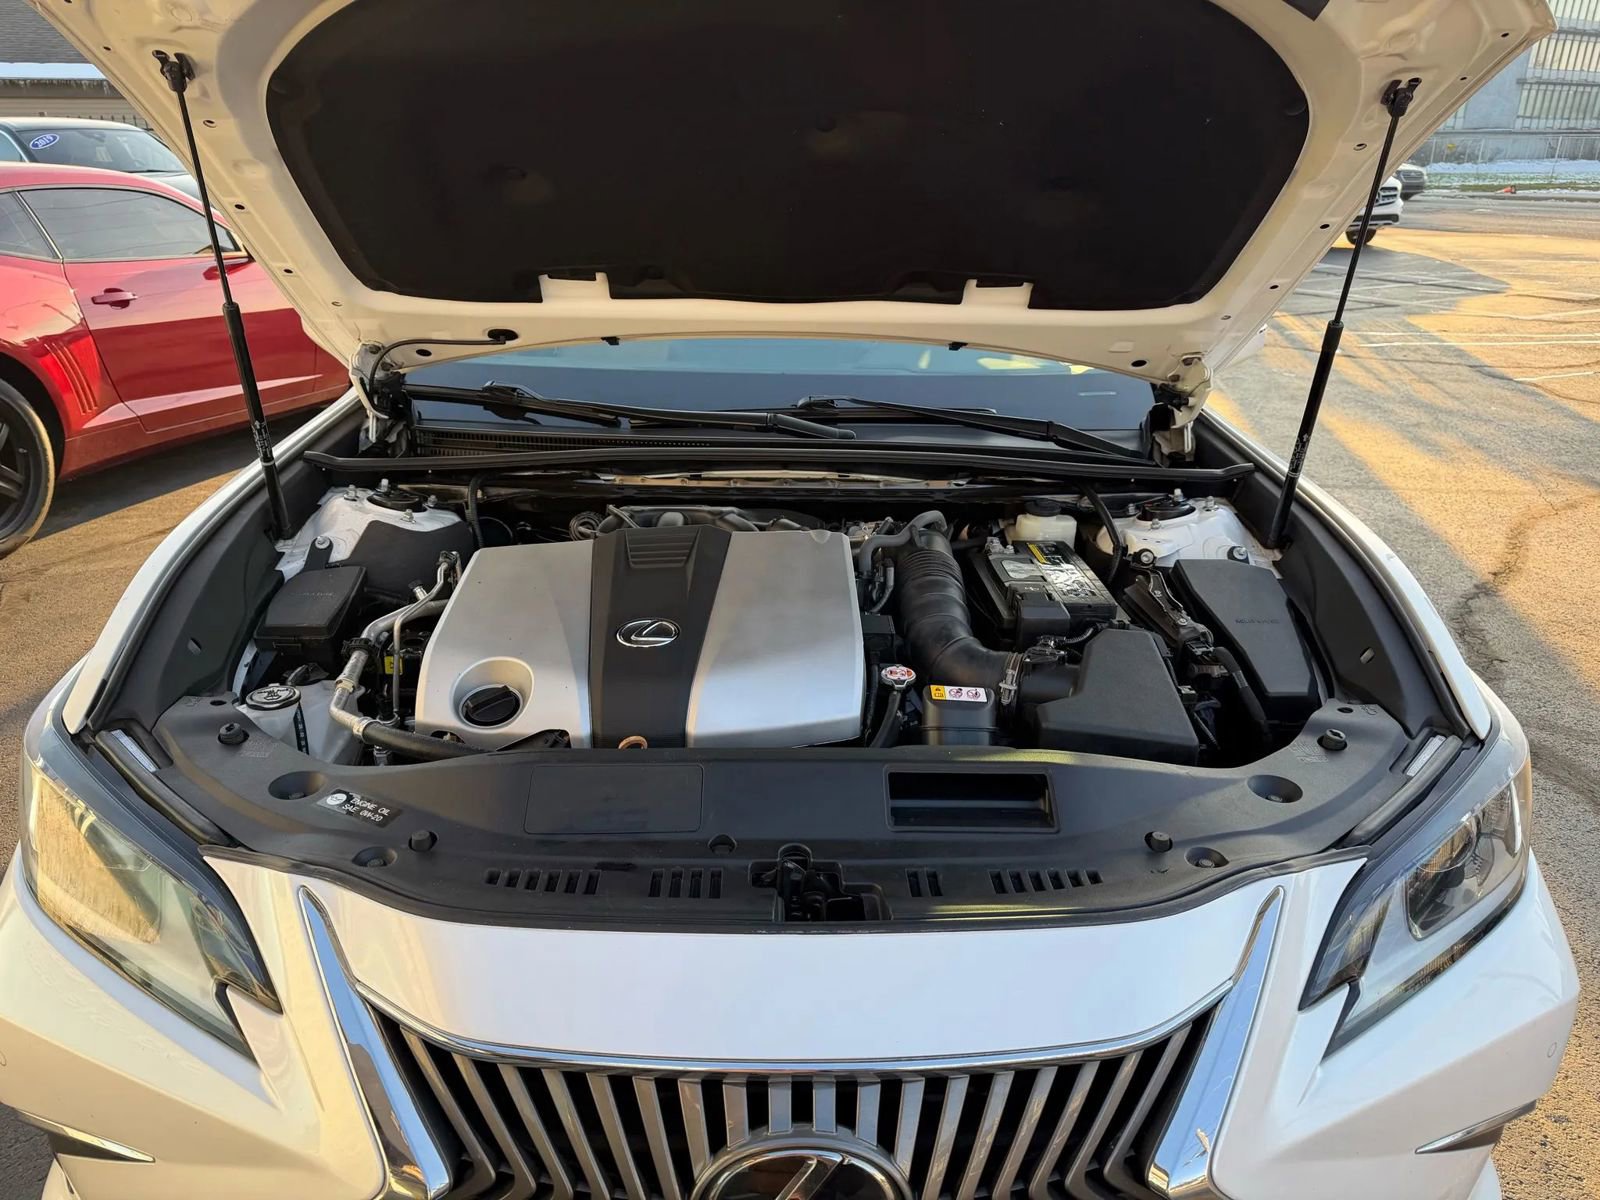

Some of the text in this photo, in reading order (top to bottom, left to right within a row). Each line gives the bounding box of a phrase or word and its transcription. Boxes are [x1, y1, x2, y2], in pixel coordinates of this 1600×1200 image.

[342, 803, 383, 821] SAE 0W-20
[350, 797, 391, 816] ENGINE OIL
